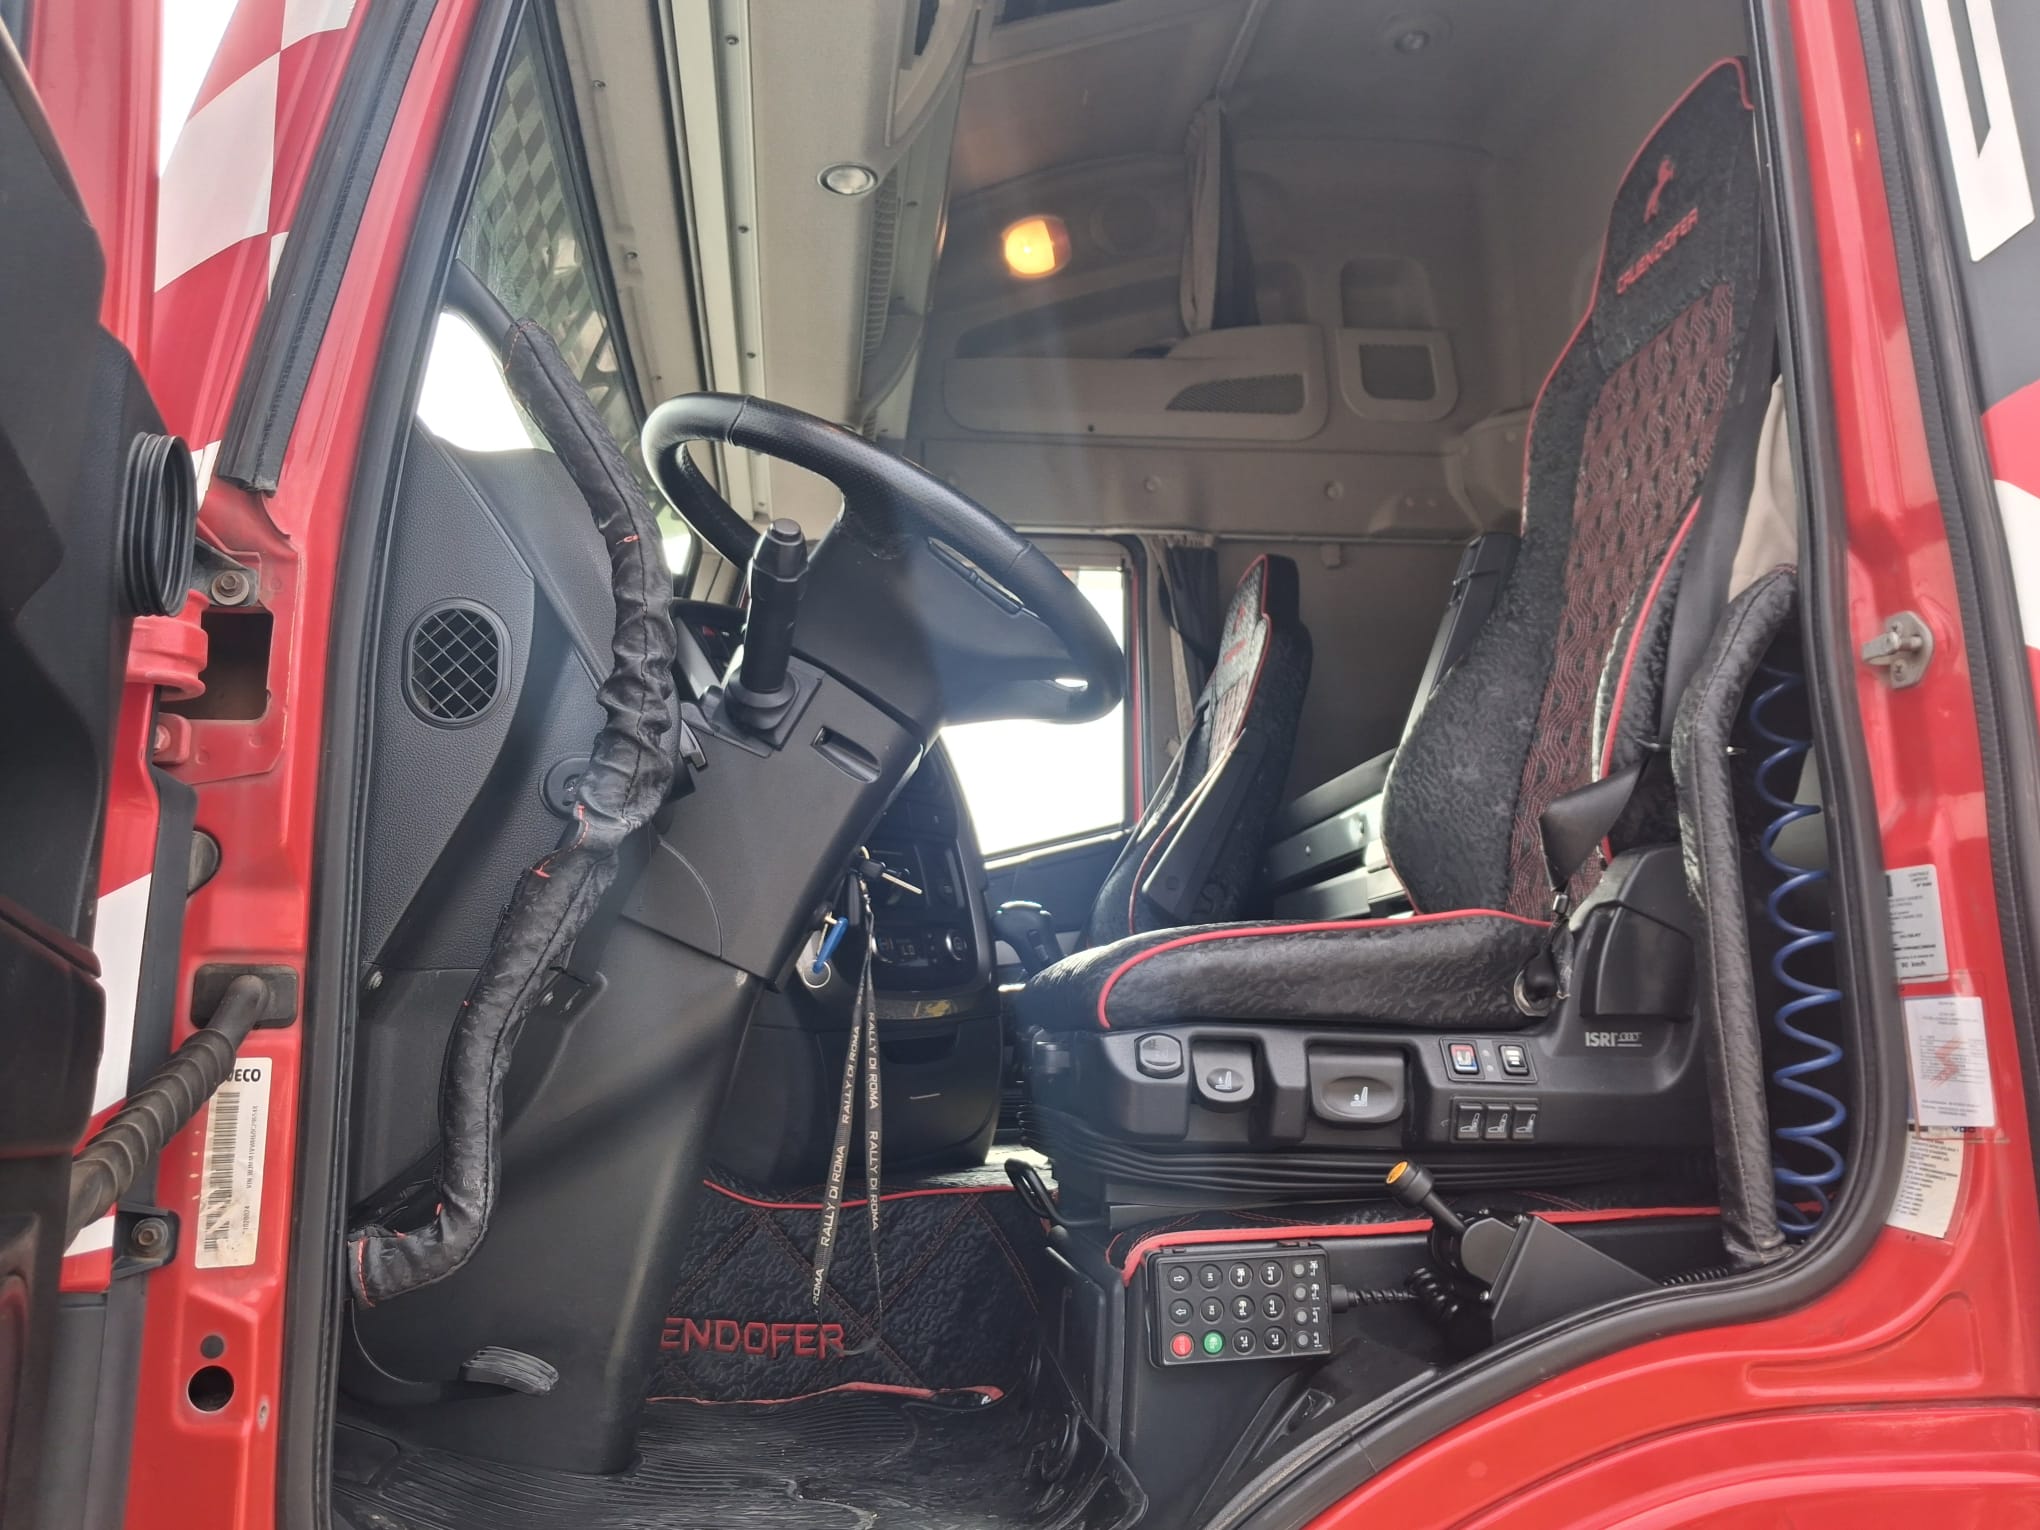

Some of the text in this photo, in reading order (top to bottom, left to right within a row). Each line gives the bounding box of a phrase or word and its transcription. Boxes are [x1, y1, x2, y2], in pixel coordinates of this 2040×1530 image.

[841, 1026, 861, 1124] RALLY DI ROMA
[868, 1012, 879, 1110] RALLY DI ROMA
[1585, 1031, 1618, 1047] ISRI
[820, 1145, 846, 1247] RALLY DI ROMA
[868, 1130, 879, 1231] RALLY DI ROMA
[812, 1268, 825, 1306] ROMA
